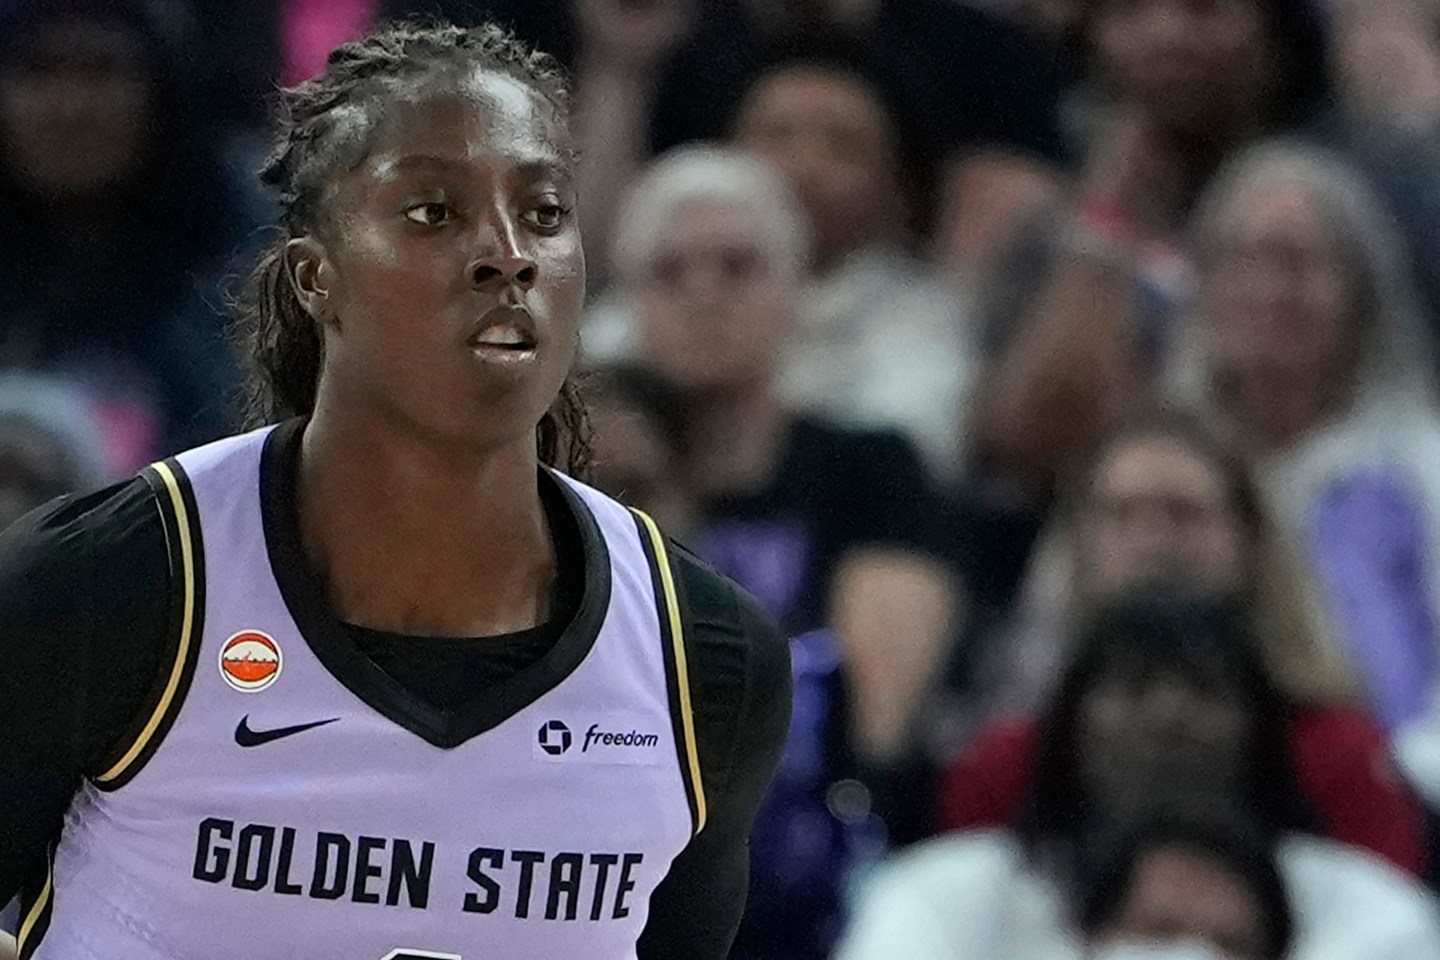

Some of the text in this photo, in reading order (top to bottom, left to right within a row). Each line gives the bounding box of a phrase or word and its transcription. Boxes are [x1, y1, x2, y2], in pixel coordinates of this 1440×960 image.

[582, 723, 658, 752] freedom
[193, 817, 644, 922] GOLDEN STATE
